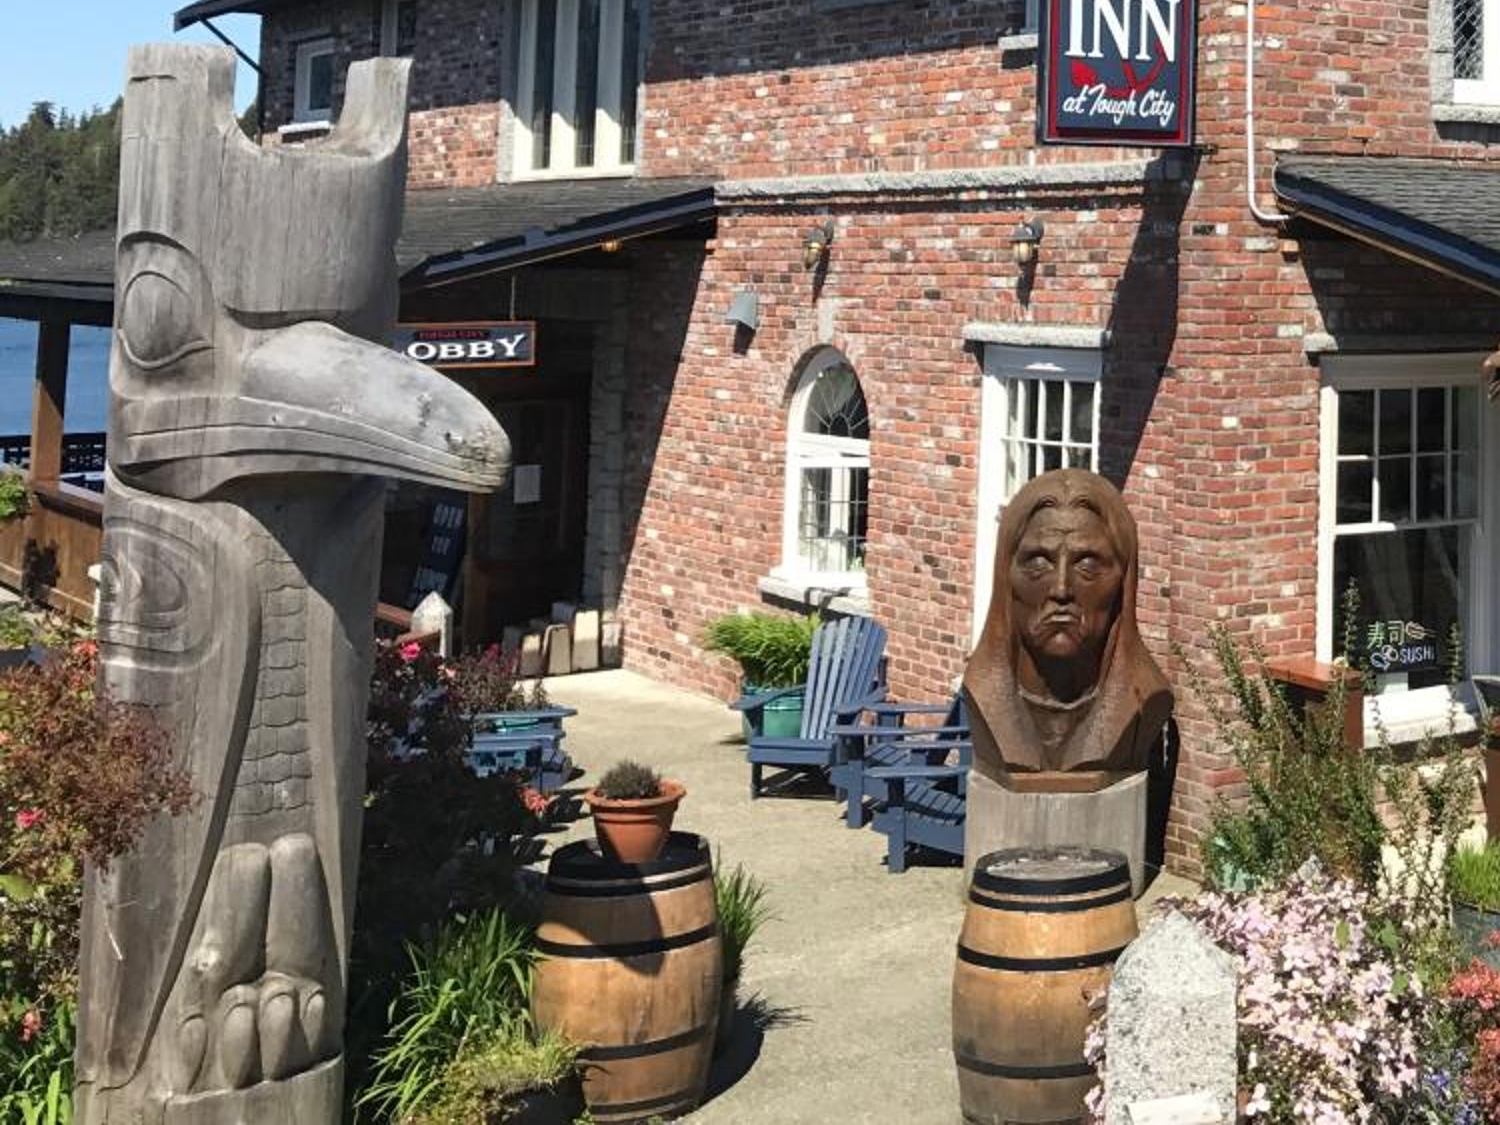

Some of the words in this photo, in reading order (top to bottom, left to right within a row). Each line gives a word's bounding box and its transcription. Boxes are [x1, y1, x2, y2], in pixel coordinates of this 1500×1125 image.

[1063, 84, 1088, 115] at
[1088, 83, 1136, 125] Tough
[1139, 89, 1175, 127] City
[401, 333, 526, 360] OBBY
[1366, 620, 1405, 650] 寿司
